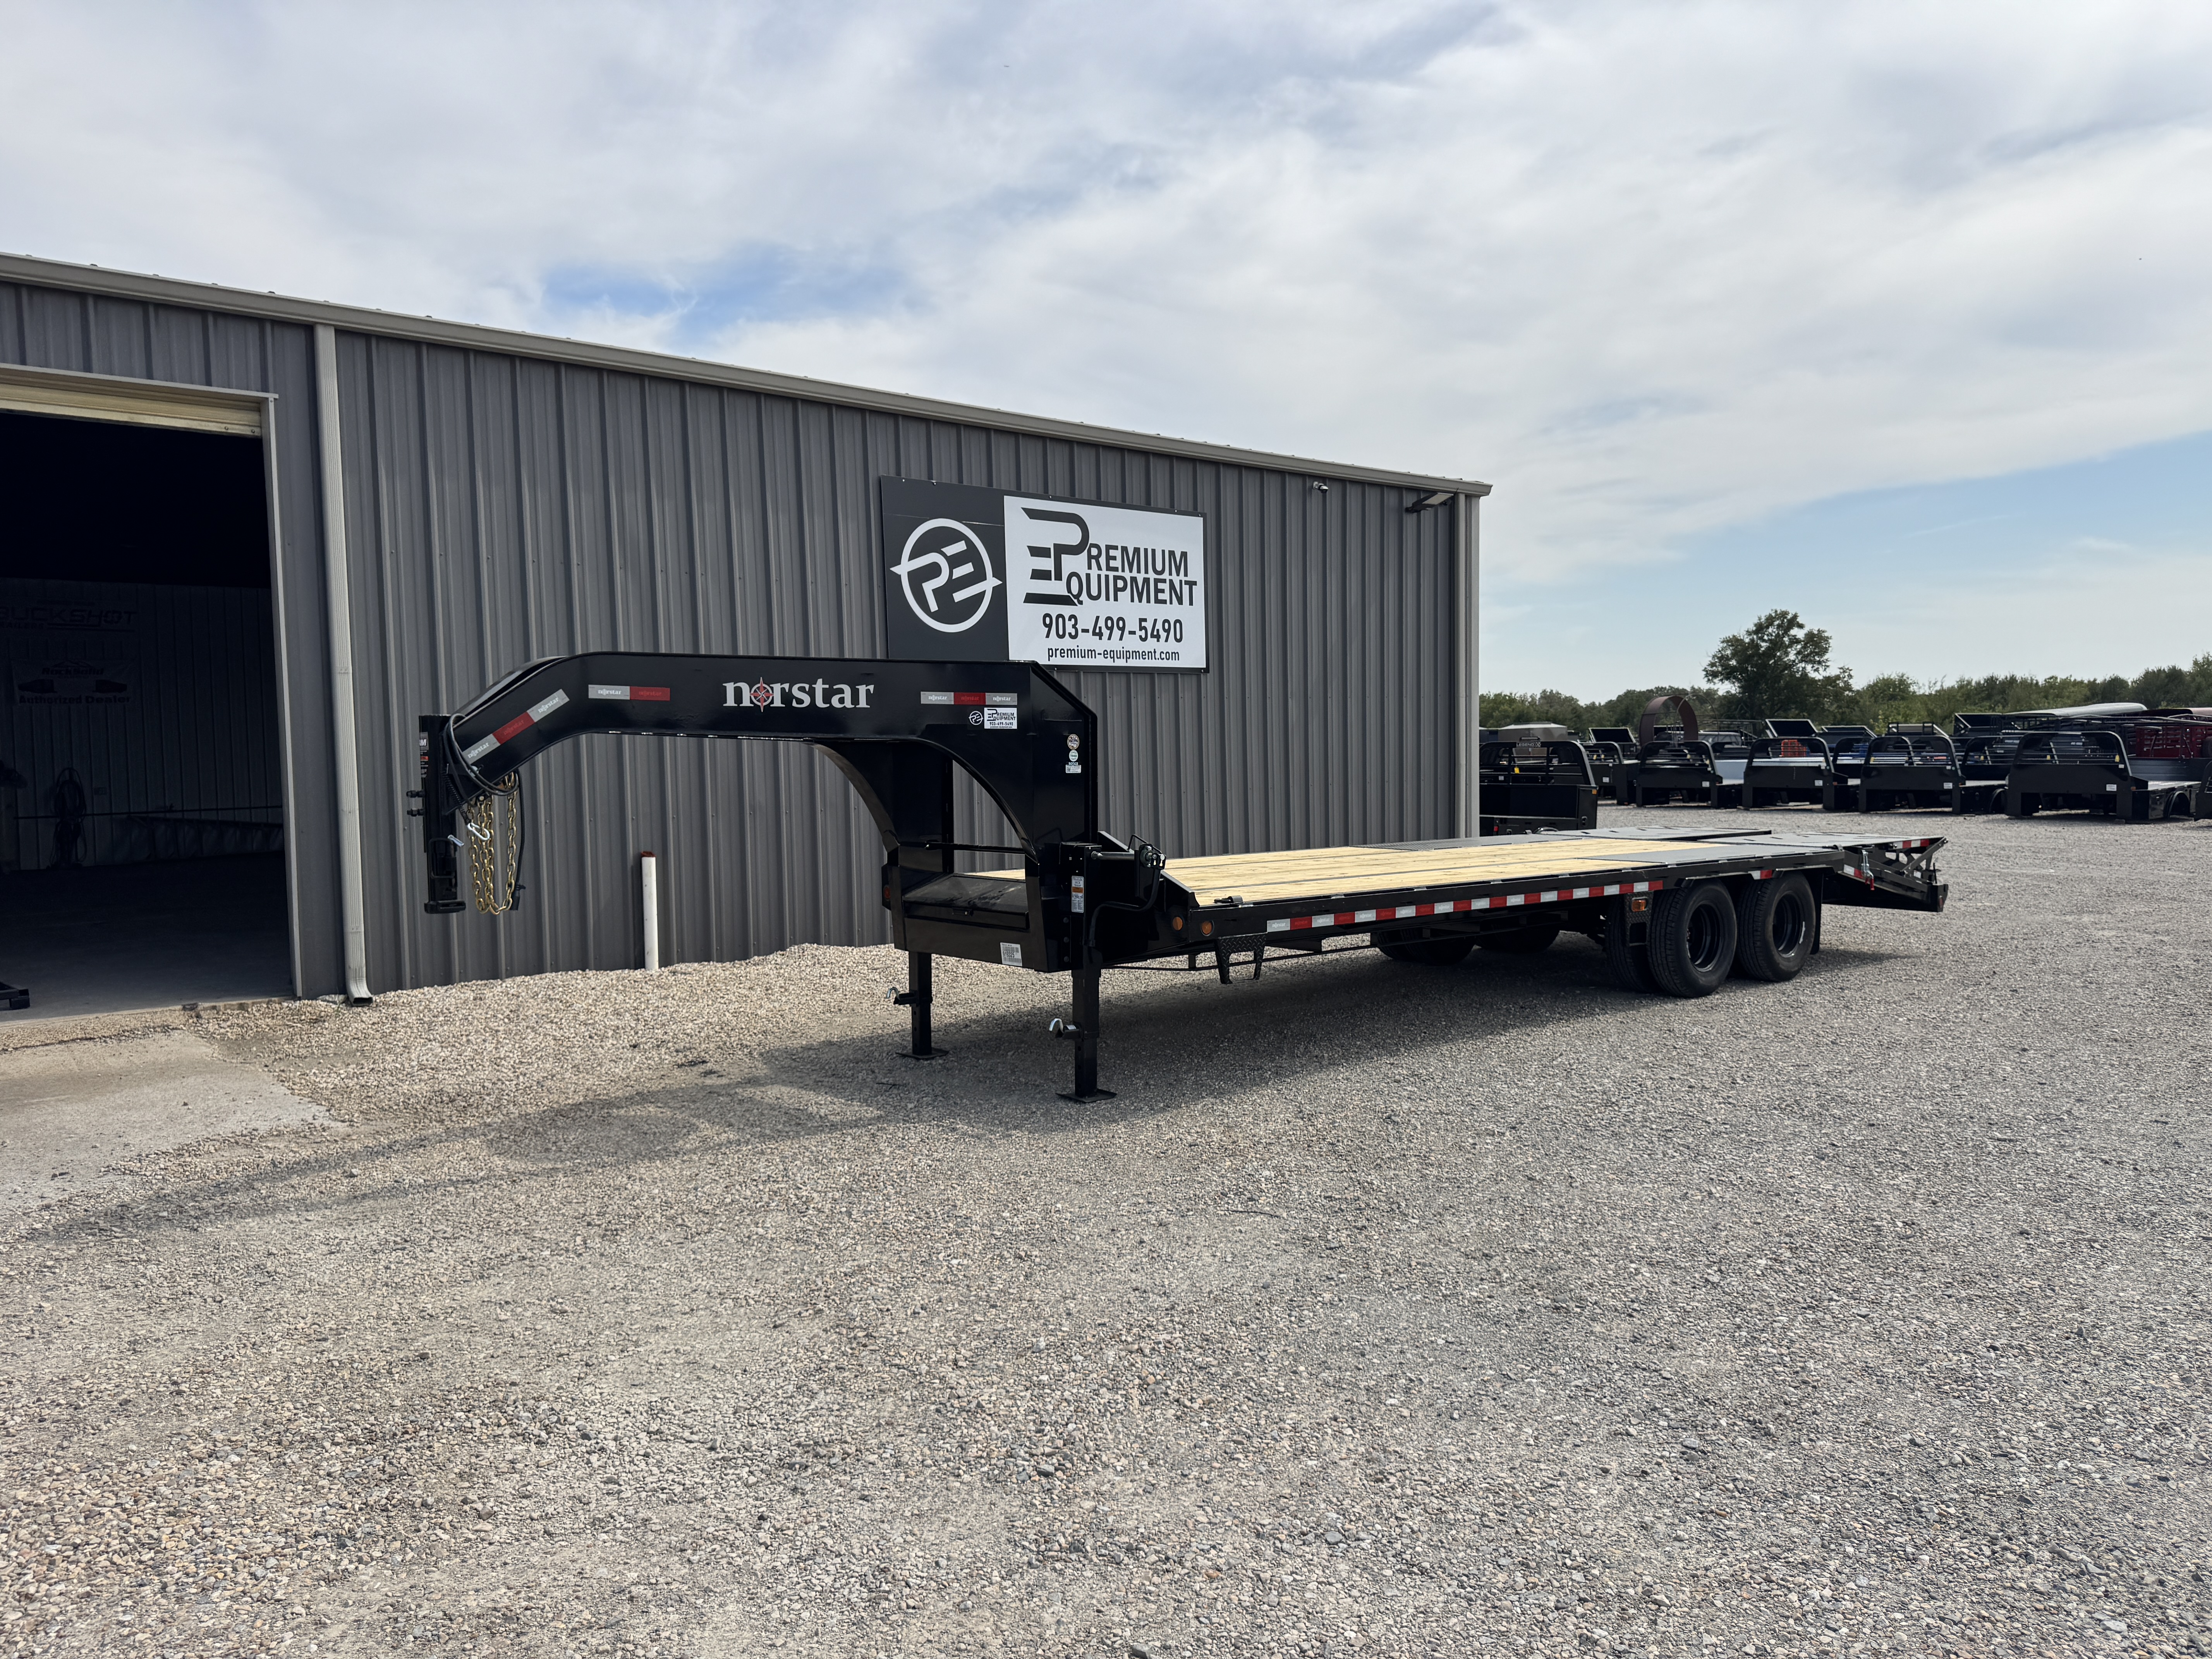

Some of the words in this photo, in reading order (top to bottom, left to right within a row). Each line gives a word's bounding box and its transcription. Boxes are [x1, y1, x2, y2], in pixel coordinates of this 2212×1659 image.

[1042, 613, 1183, 643] 903-499-5490
[1048, 646, 1180, 661] premium-equipment.com
[19, 695, 82, 704] Authorized
[85, 695, 130, 704] Dealer
[722, 677, 874, 712] norstar
